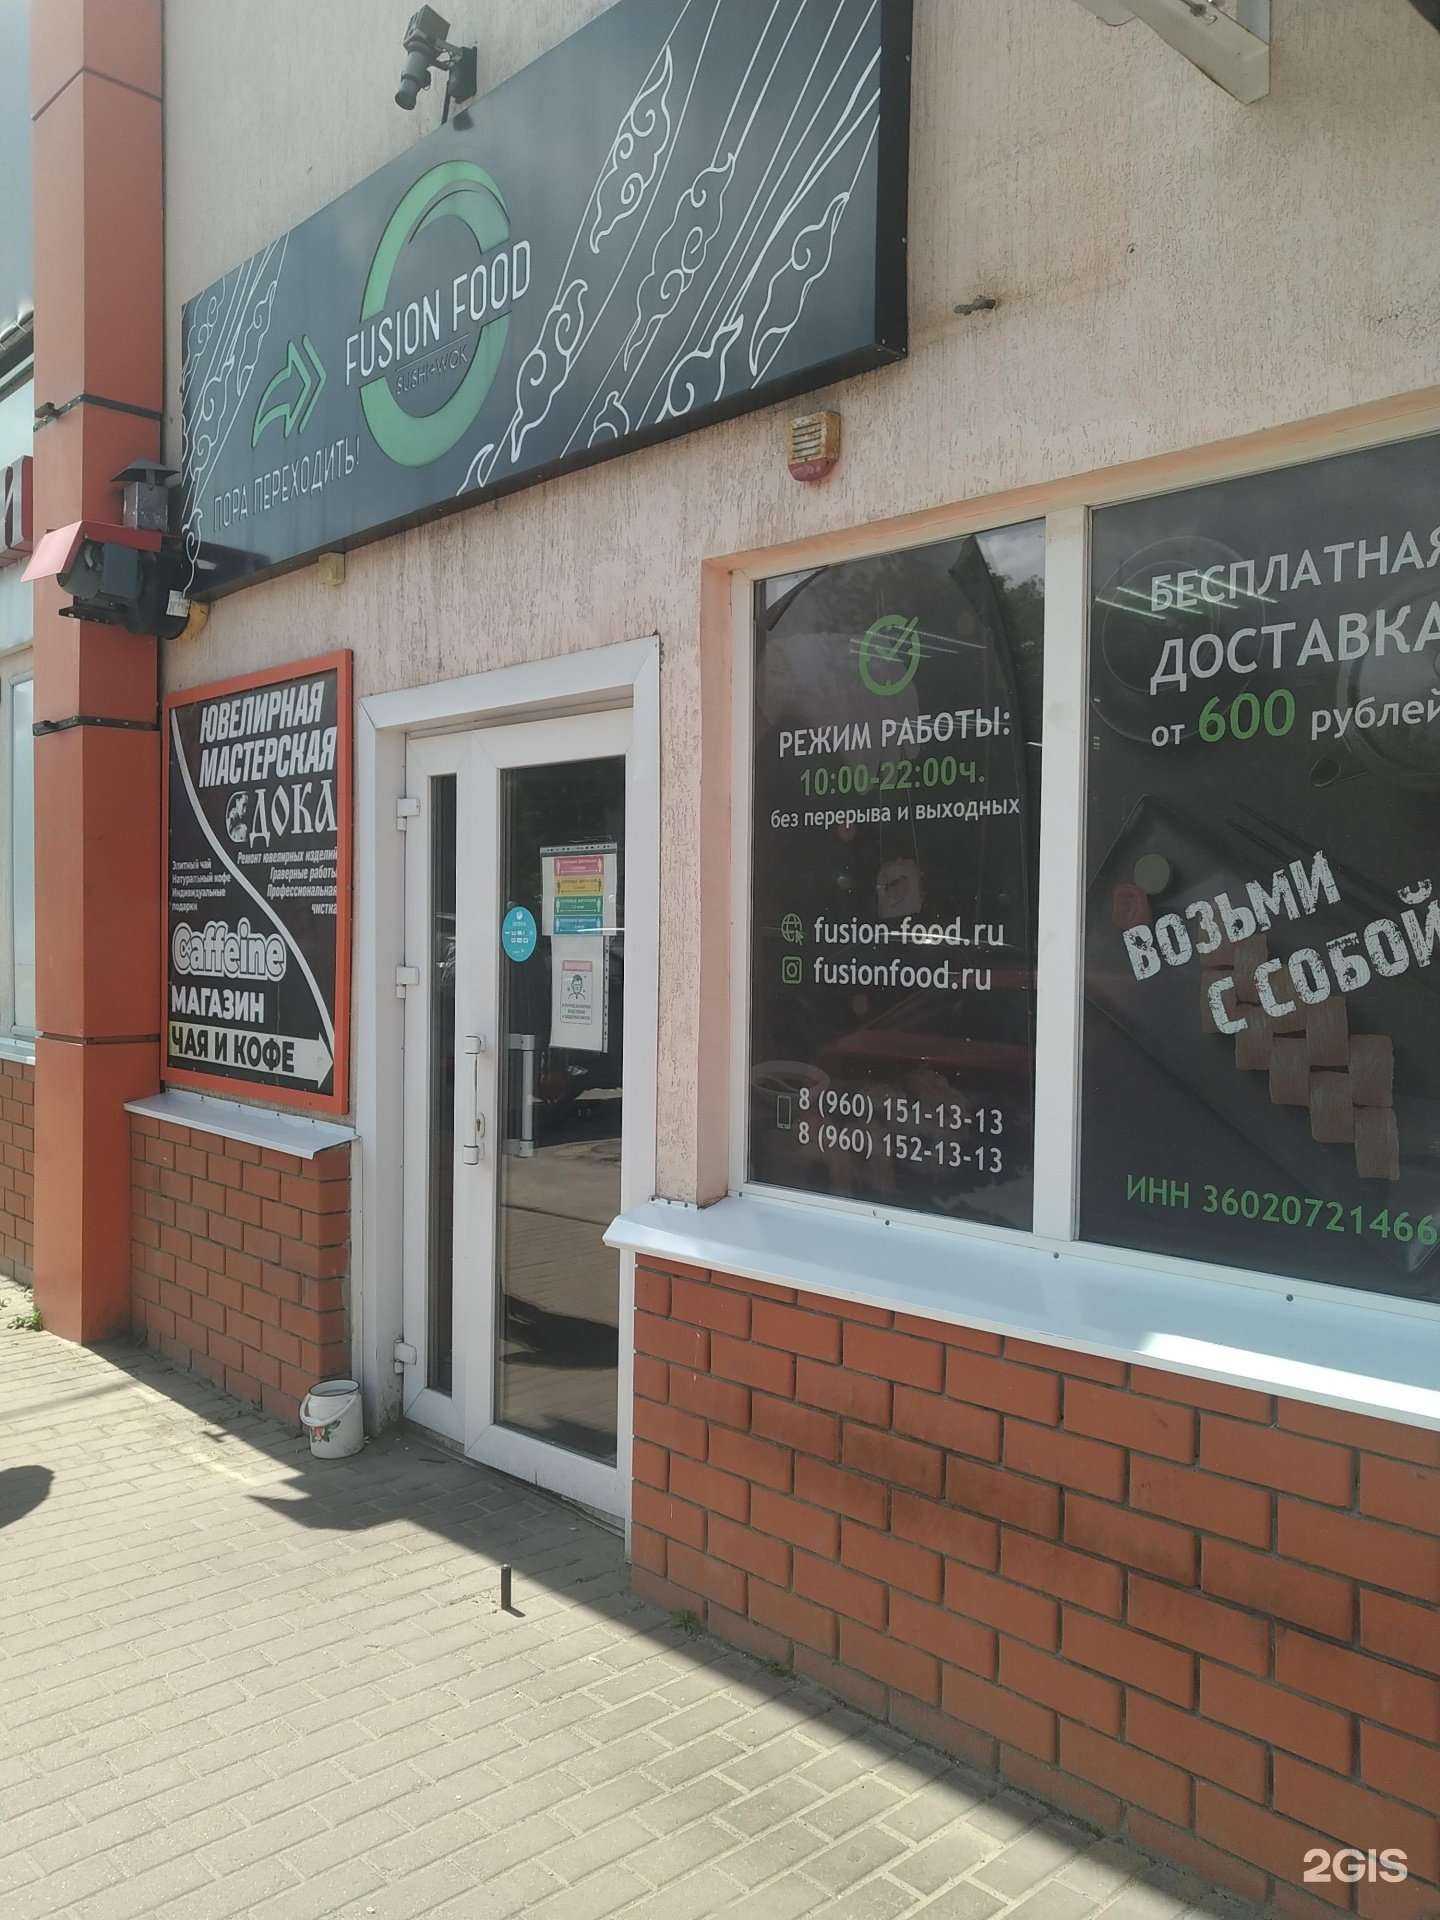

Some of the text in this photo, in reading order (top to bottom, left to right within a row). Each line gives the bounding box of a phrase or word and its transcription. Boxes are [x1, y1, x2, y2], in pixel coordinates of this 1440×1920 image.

[346, 240, 531, 386] FUSION FOOD
[213, 434, 360, 530] ПОРА ПЕРЕХОДИТЬ!
[1150, 600, 1440, 696] ДОСТАВКА
[199, 681, 325, 744] ЮВЕЛИРНАЯ
[779, 706, 1010, 758] РЕЖИМ РАБОТЫ:
[1151, 723, 1185, 746] от
[1199, 688, 1296, 742] 600
[199, 727, 338, 788] МАСТЕРСКАЯ
[800, 756, 985, 797] 10:00-22:00ч.
[250, 779, 338, 848] ДОКА
[771, 798, 1020, 830] без перерыва и выходных
[267, 883, 337, 900] Профессиональная
[270, 866, 308, 883] Граверные
[814, 916, 1004, 946] fusion-food.ru
[1122, 850, 1342, 981] ВОЗЬМИ
[172, 917, 286, 982] Caffeine
[814, 957, 991, 990] fusionfood.ru
[1208, 879, 1440, 1034] С СОБОЙ
[172, 985, 264, 1023] МАГАЗИН
[171, 1026, 295, 1073] ЧАЯ И КОФЕ
[799, 1087, 1003, 1135] 8 (960) 151-13-13
[798, 1121, 1003, 1173] 8 (960) 152-13-13
[1127, 1174, 1438, 1245] ИНН 36020721466
